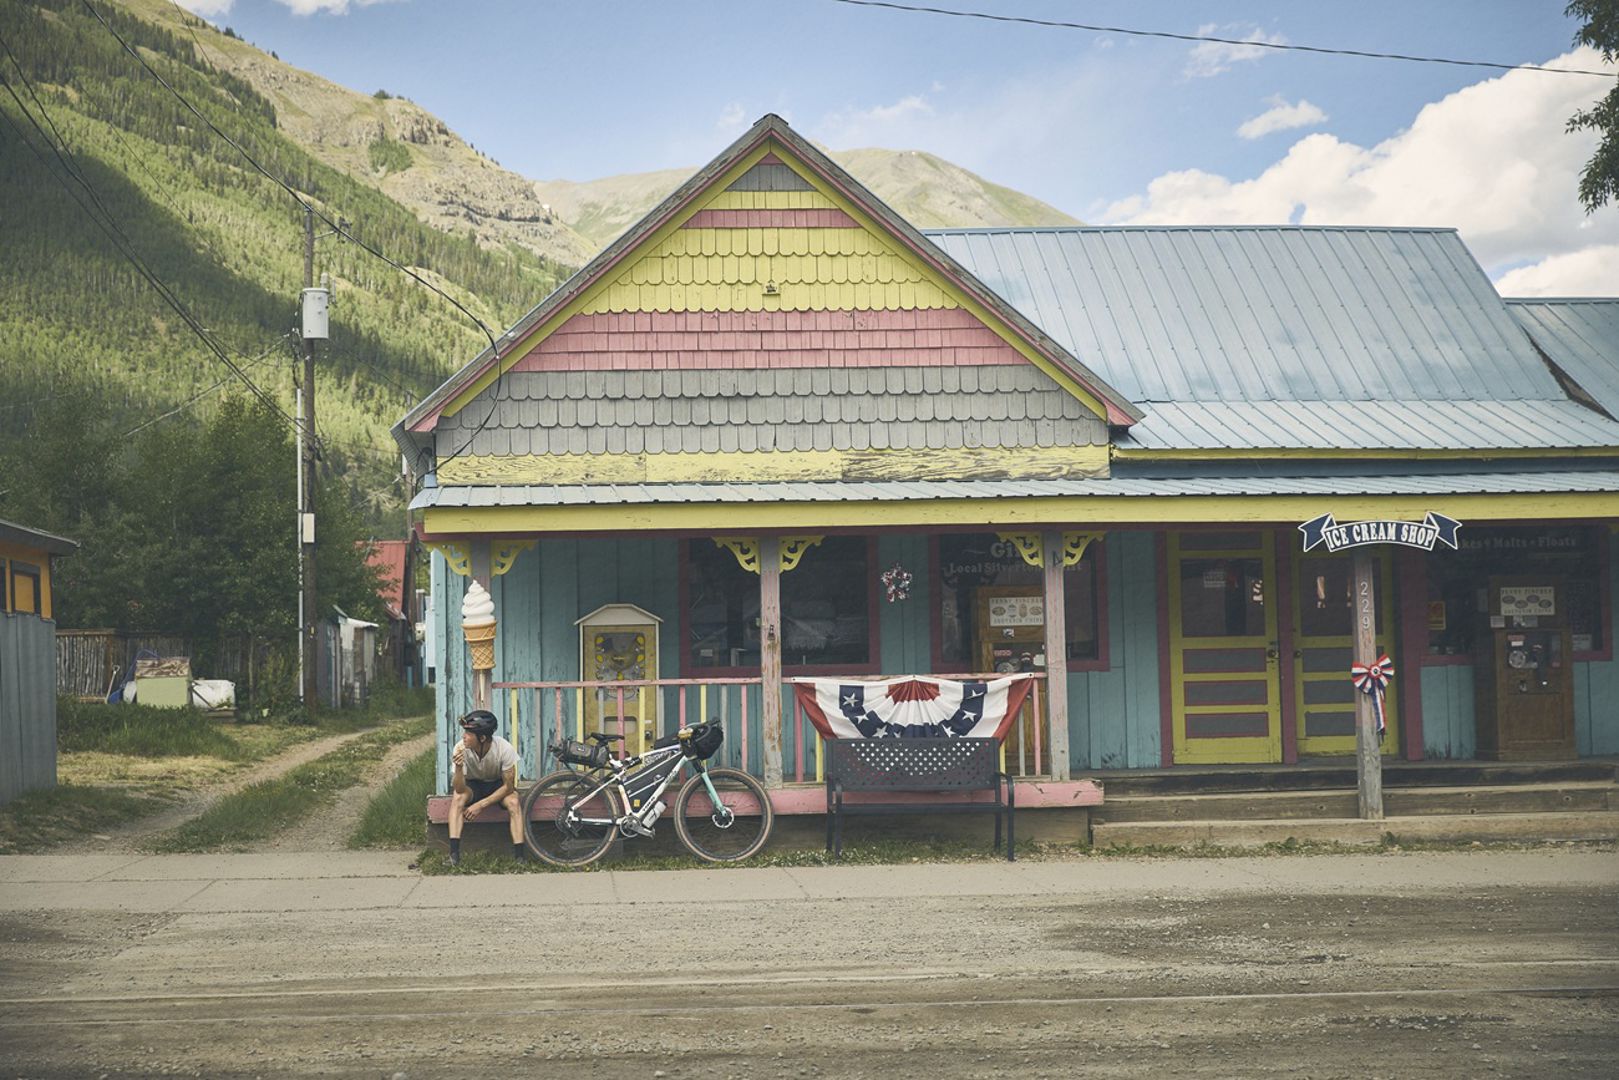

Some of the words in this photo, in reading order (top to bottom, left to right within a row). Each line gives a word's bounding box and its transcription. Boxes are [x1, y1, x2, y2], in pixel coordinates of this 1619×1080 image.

[1327, 529, 1349, 549] ICE
[1352, 523, 1396, 541] CREAM
[1400, 523, 1434, 547] SHOP
[1493, 537, 1527, 548] Malts
[1537, 536, 1575, 547] Floats
[943, 562, 982, 576] Local
[1360, 581, 1371, 629] 229
